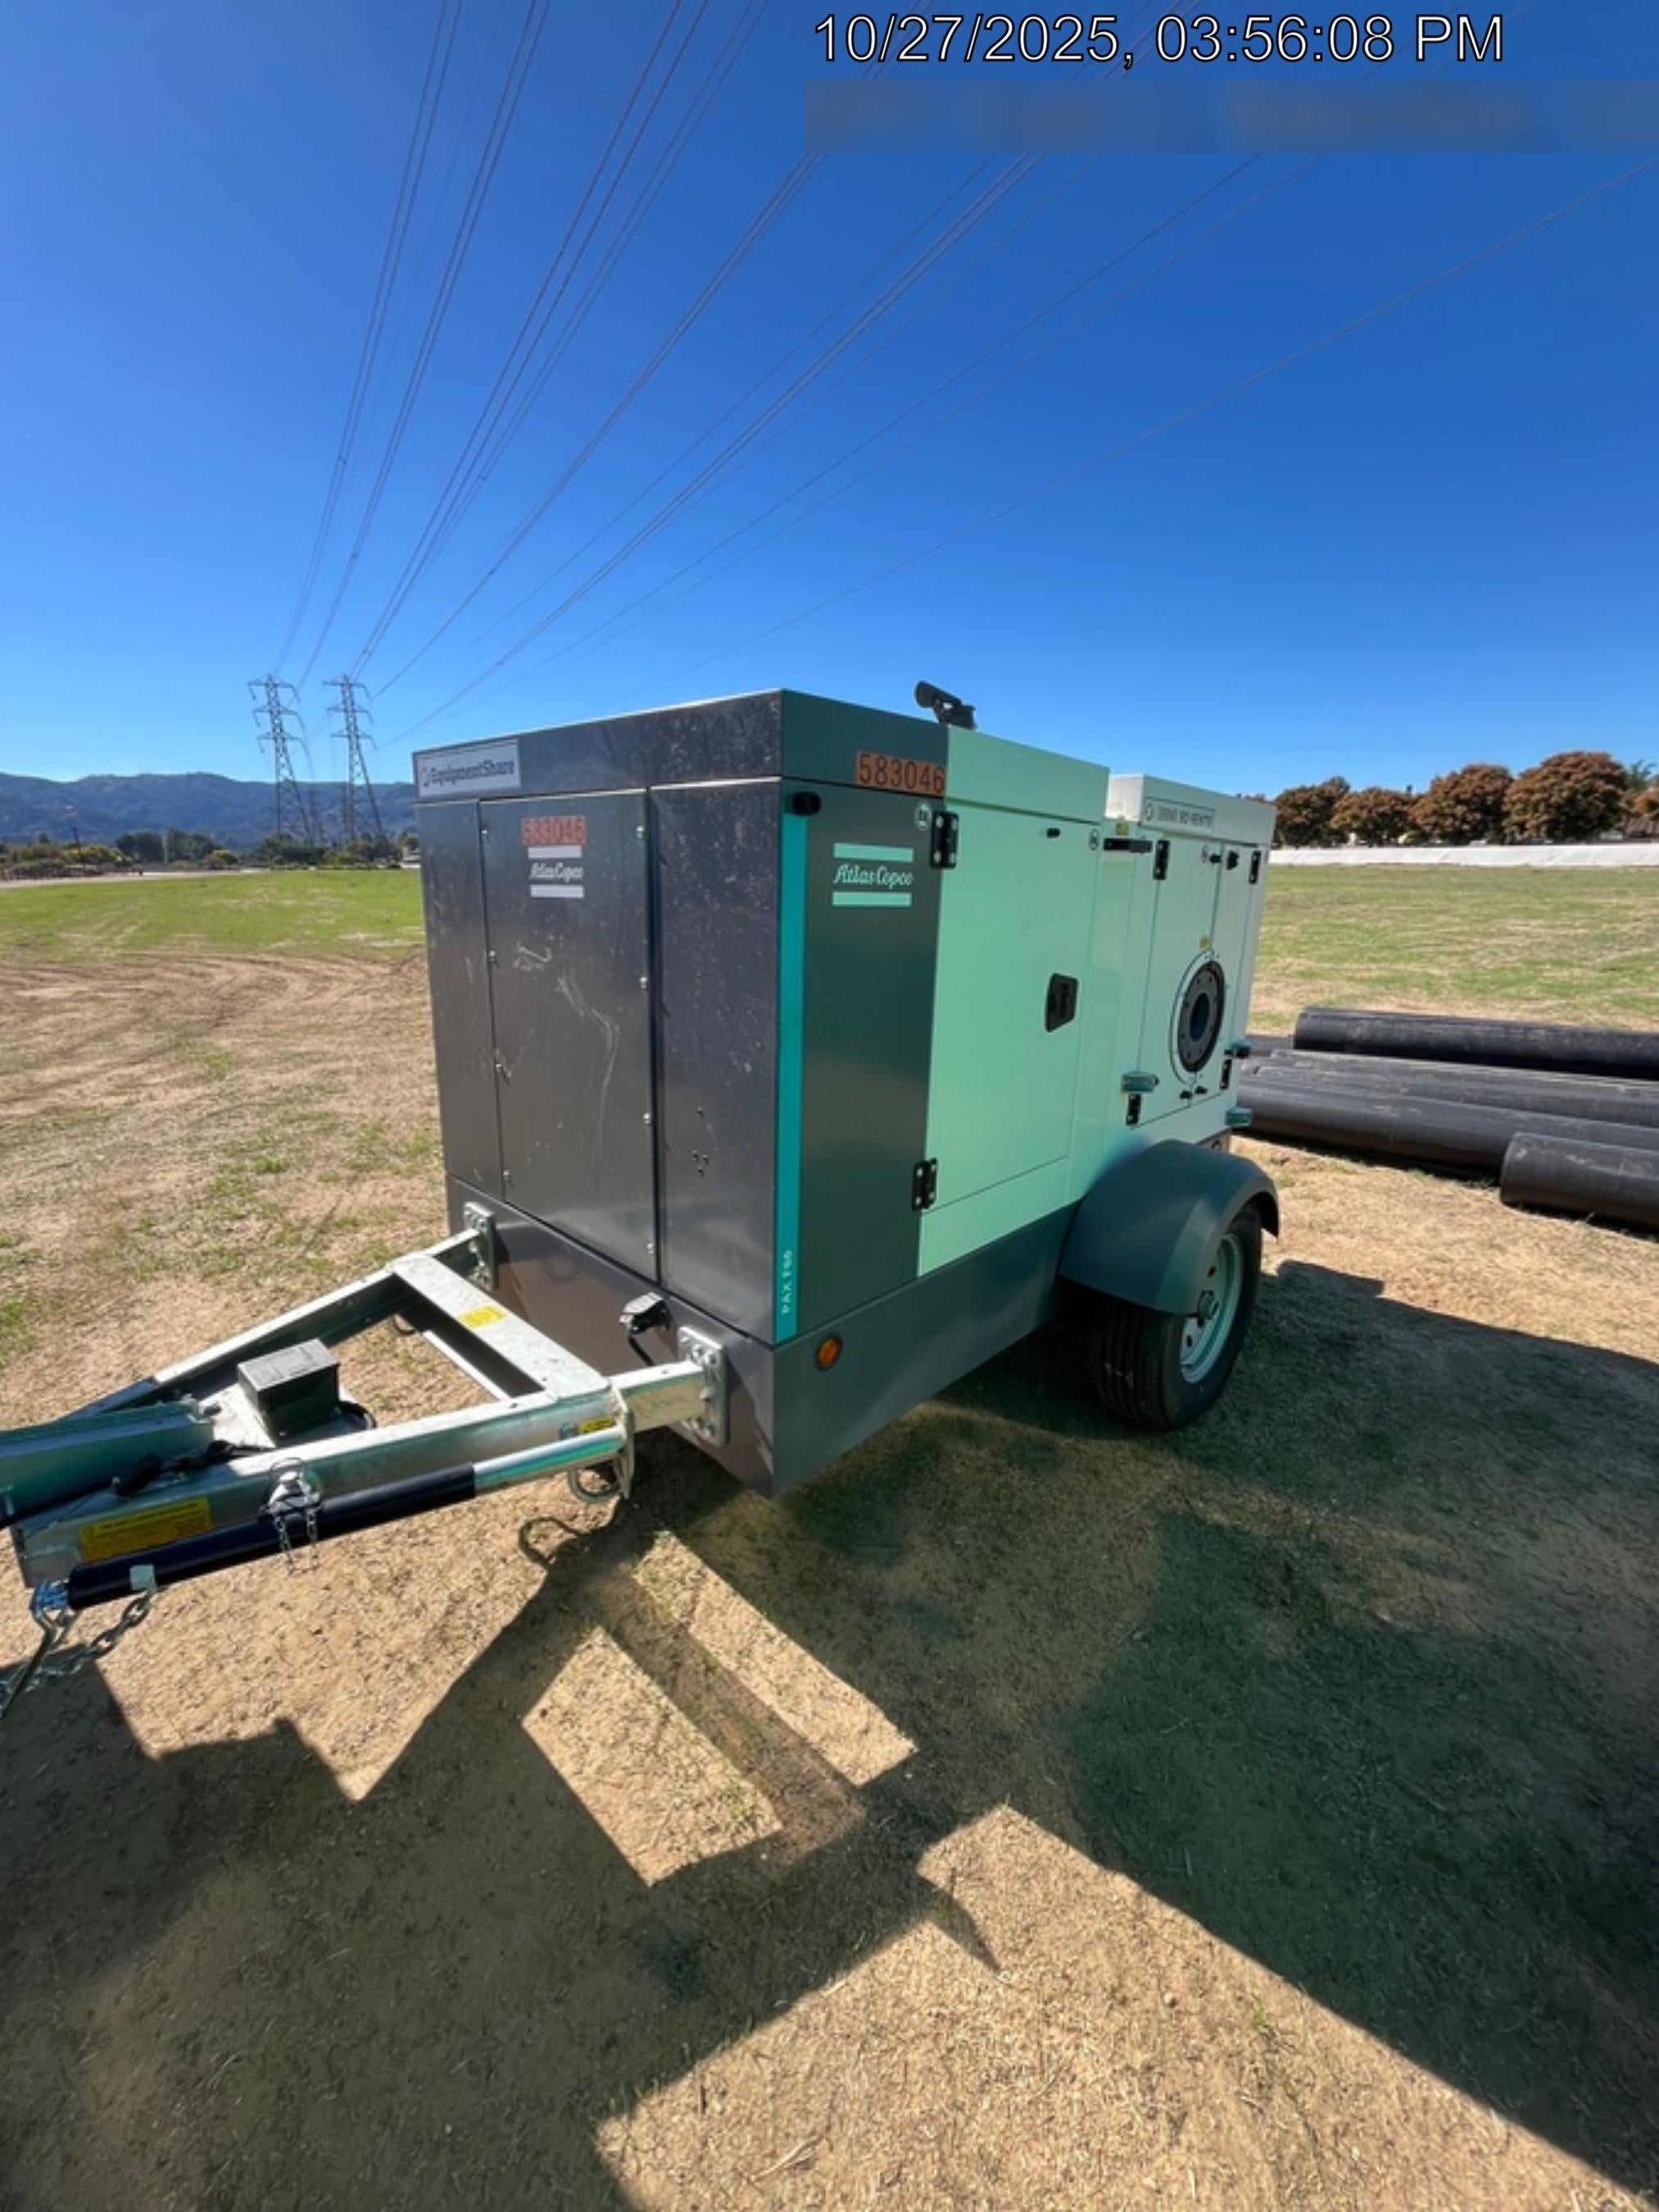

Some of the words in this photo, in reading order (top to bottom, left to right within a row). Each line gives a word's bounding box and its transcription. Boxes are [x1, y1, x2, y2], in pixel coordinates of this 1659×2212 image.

[859, 754, 945, 794] 583046
[523, 816, 584, 845] 583046
[530, 863, 555, 879] Atlas
[555, 863, 583, 882] Copco
[833, 863, 875, 885] Atlas
[876, 865, 914, 889] Copco
